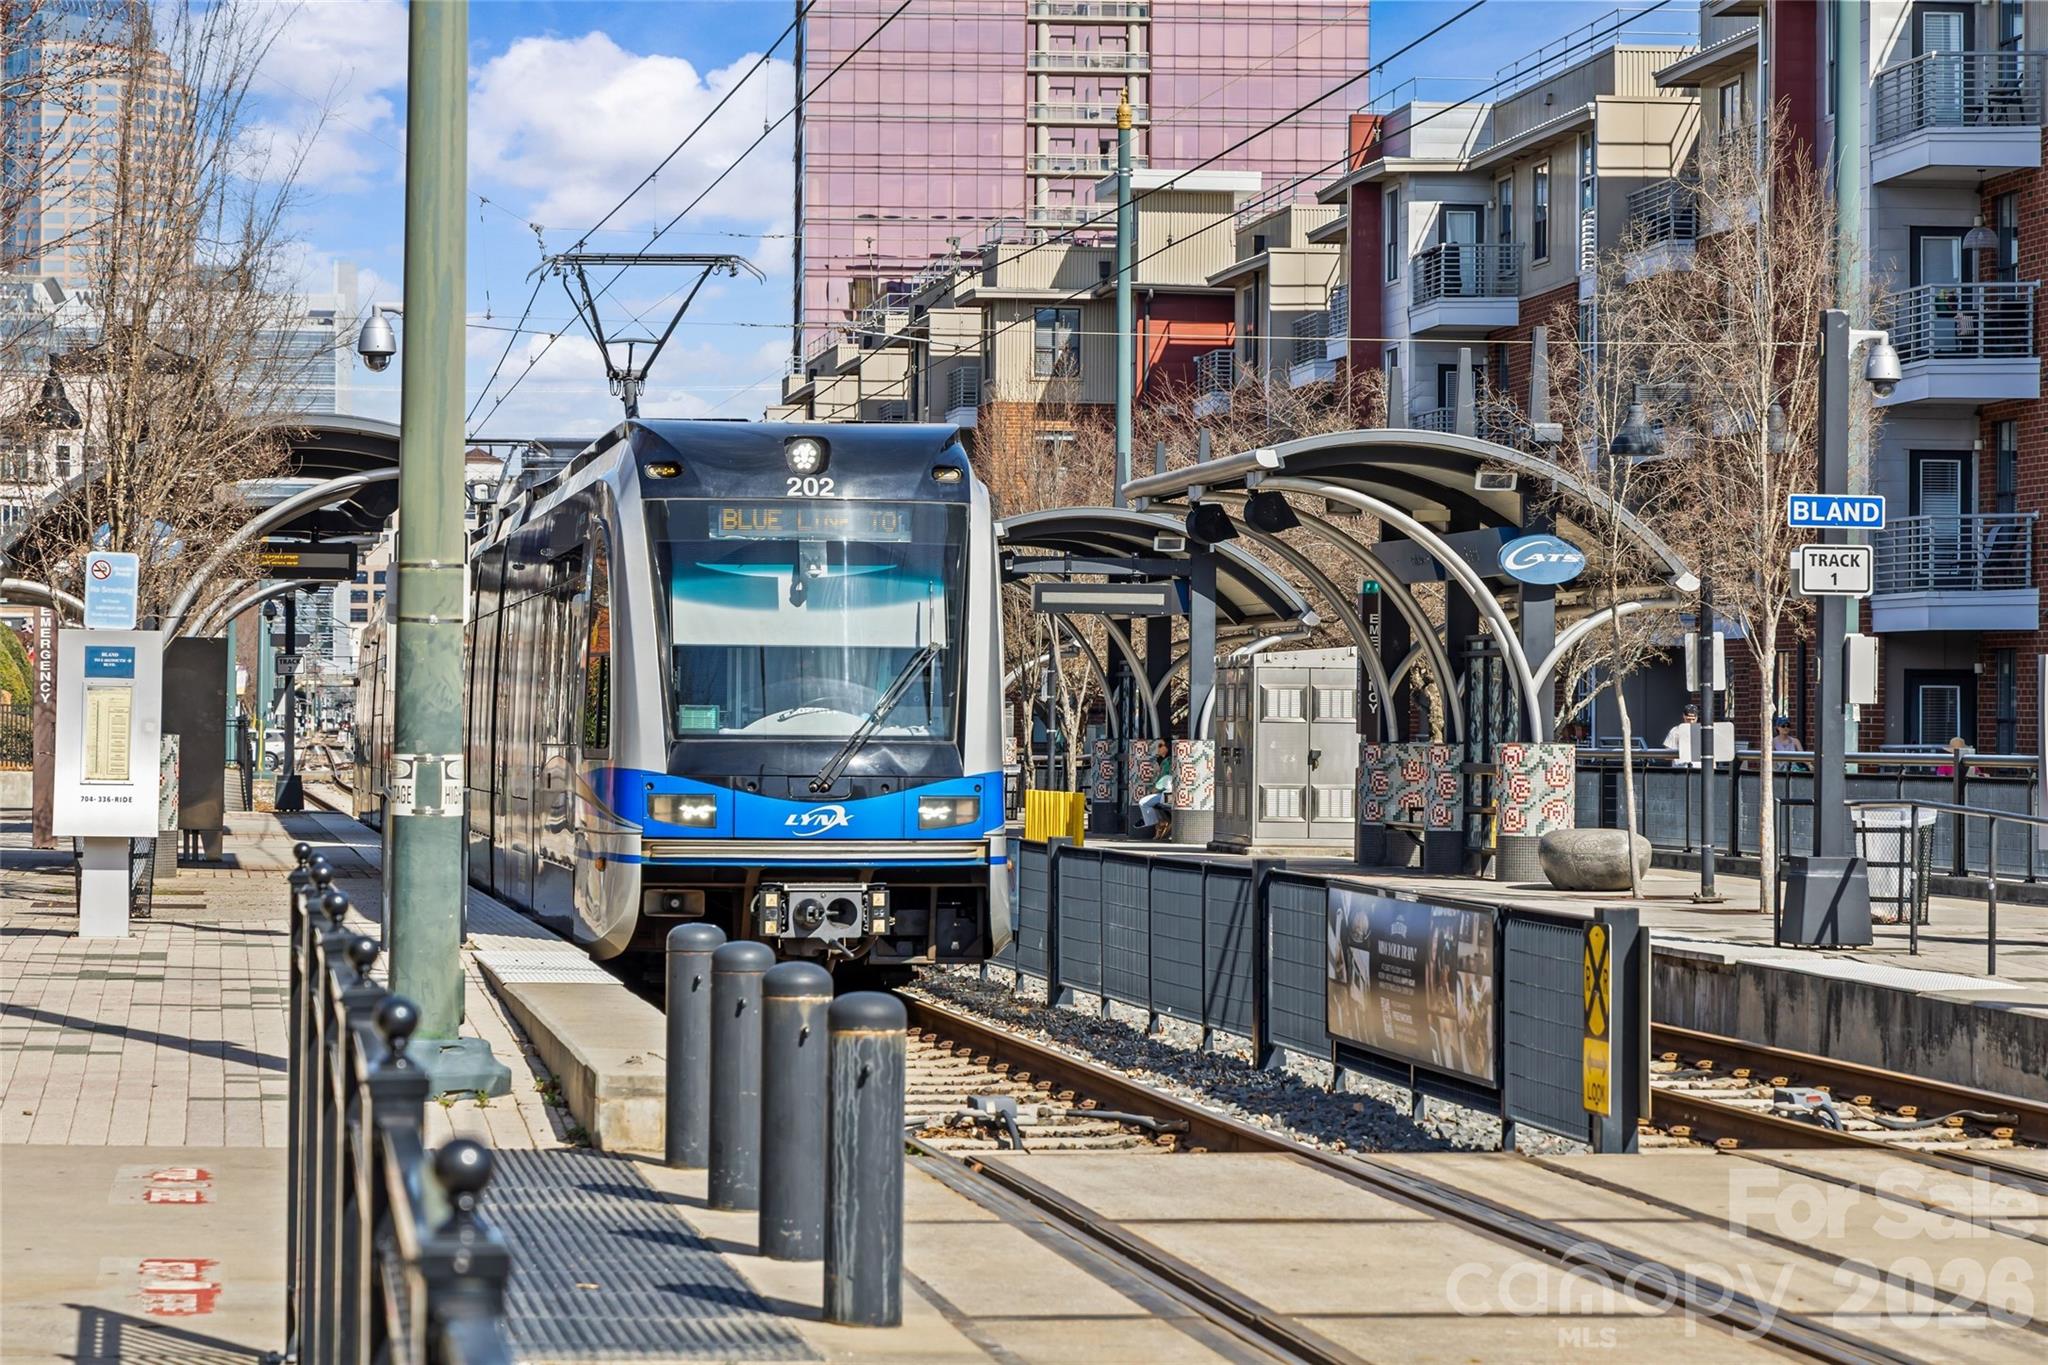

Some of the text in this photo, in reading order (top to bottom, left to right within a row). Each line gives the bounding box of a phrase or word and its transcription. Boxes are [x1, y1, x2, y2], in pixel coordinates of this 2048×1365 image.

[786, 477, 835, 497] 202
[721, 508, 784, 531] BLUE
[1793, 501, 1880, 522] BLAND
[1505, 541, 1583, 570] CATS
[1809, 553, 1860, 567] TRACK
[1830, 573, 1837, 585] 1
[40, 606, 51, 703] EMERGENCY
[784, 805, 855, 829] LYNX
[1587, 1082, 1606, 1104] LOOK
